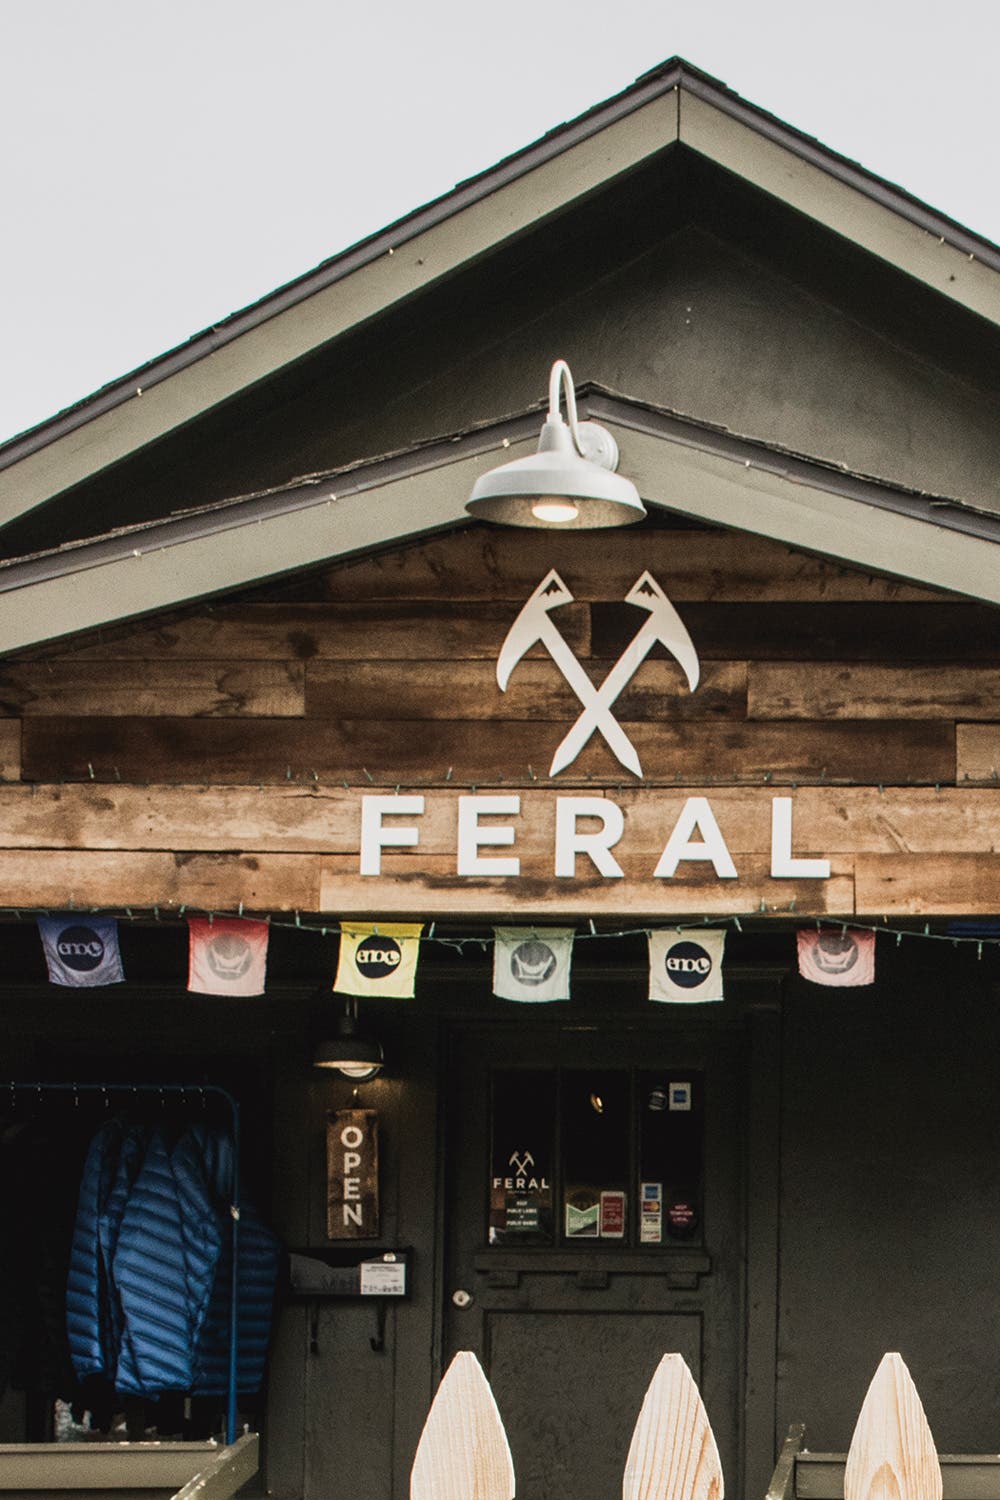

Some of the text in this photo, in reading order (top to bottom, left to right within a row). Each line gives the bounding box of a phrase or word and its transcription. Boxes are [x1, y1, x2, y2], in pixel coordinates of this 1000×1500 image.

[360, 795, 831, 879] FERAL
[340, 1126, 364, 1227] OPEN
[493, 1177, 550, 1190] FERAL
